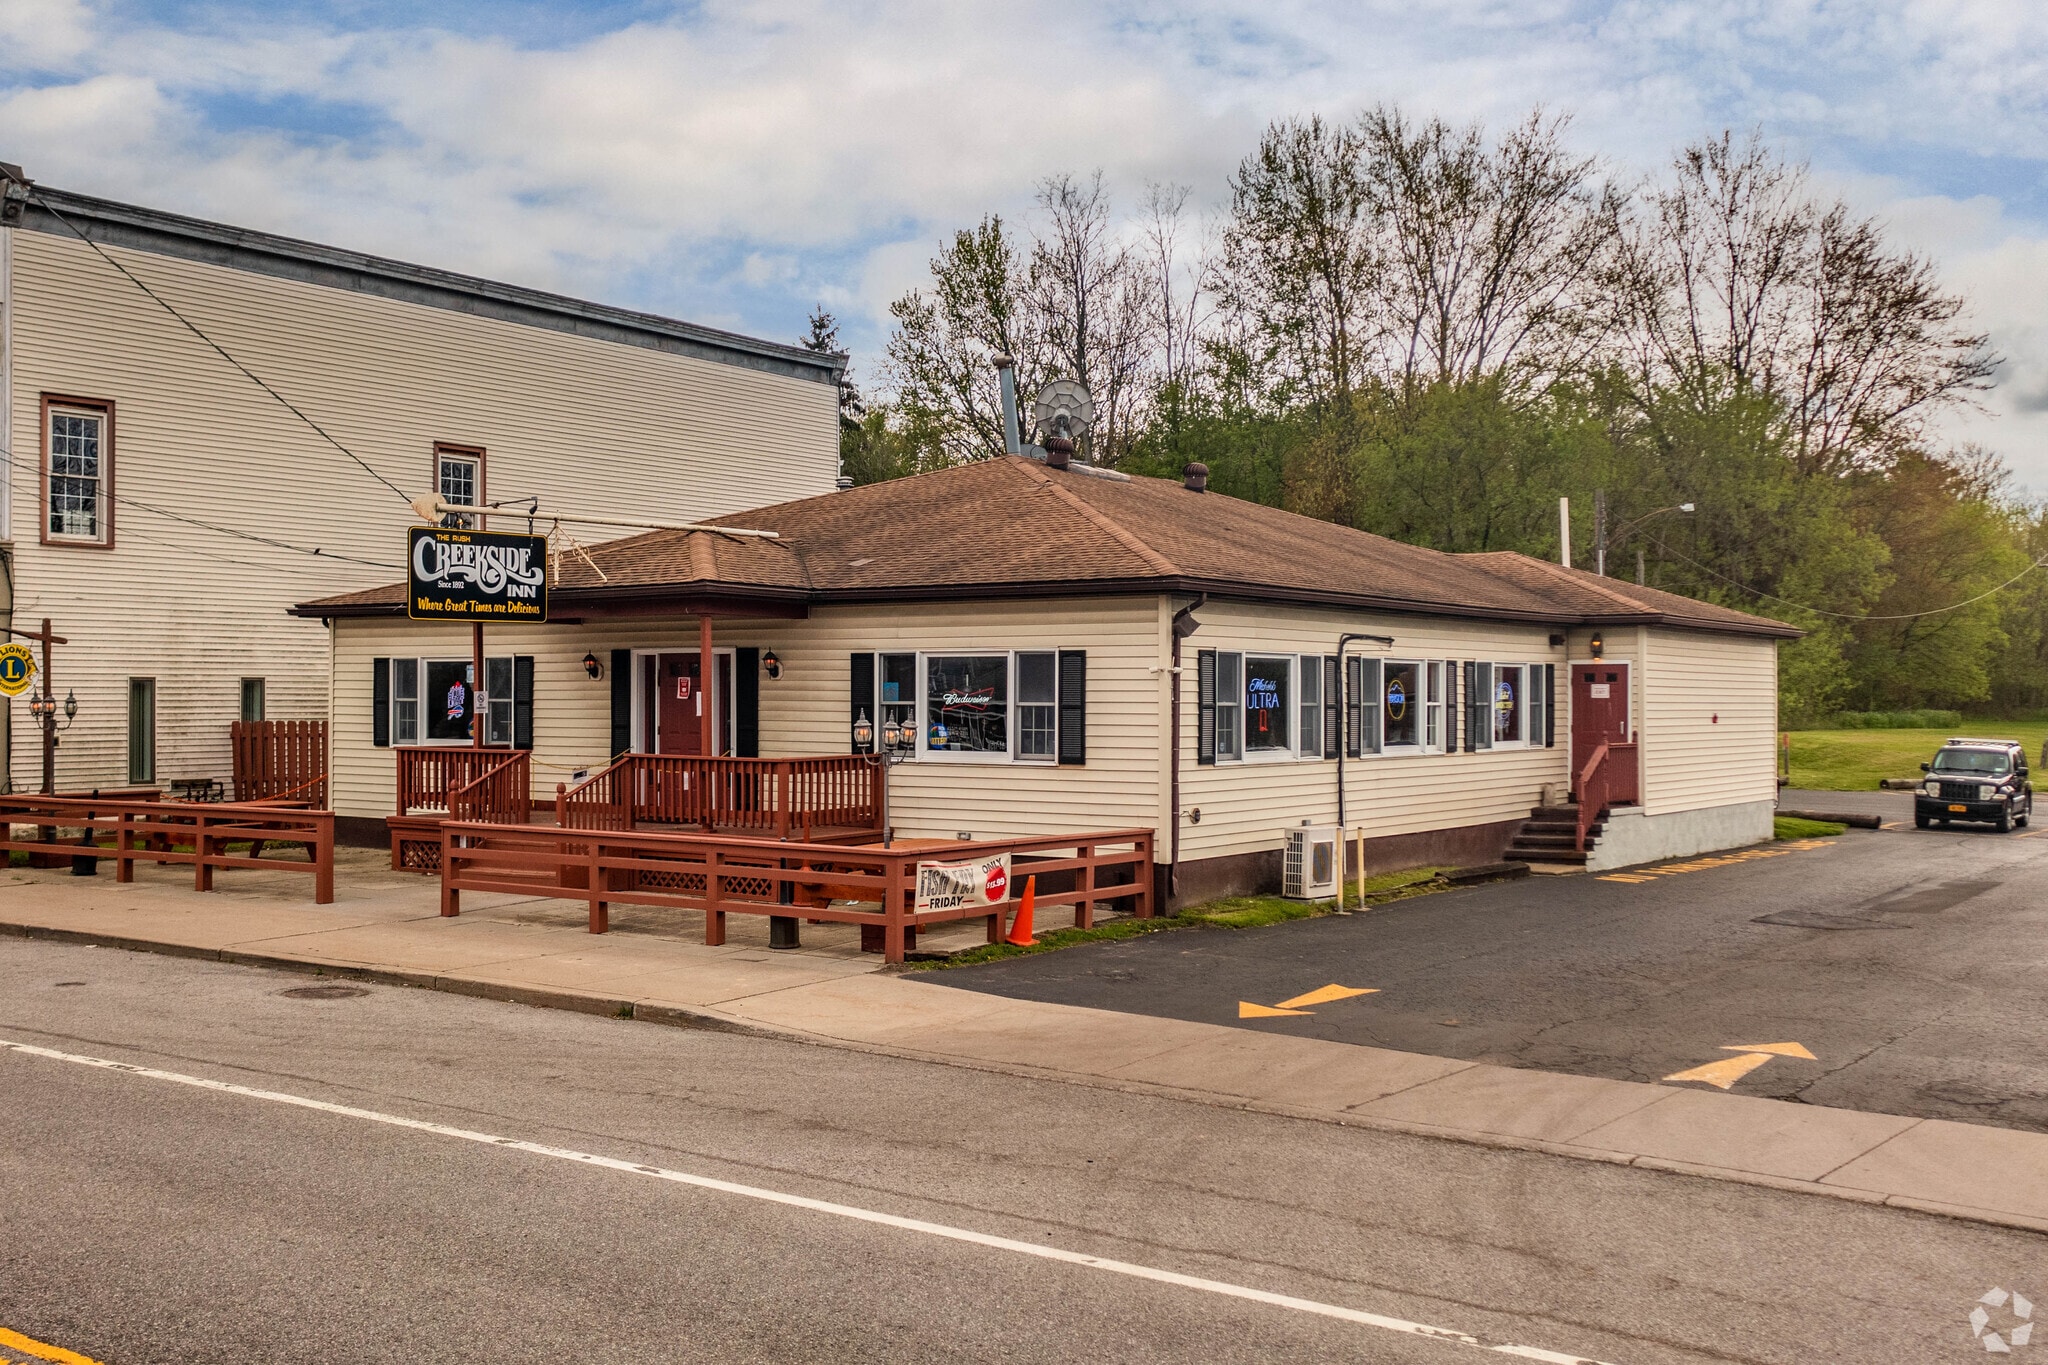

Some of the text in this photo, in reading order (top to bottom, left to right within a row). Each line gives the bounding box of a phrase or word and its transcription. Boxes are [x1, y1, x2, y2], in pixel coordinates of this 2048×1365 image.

[413, 536, 544, 594] CREEKSIDE
[438, 580, 465, 589] Since 1892
[507, 584, 536, 598] INN
[445, 598, 468, 612] Great
[469, 600, 492, 613] Times
[493, 603, 506, 613] are
[508, 600, 540, 615] Delicious
[0, 646, 27, 657] LIONS
[5, 659, 20, 679] L
[943, 693, 991, 705] Budweiser
[1246, 692, 1280, 709] ULTRA
[981, 858, 1002, 874] ONLY
[919, 869, 950, 897] FISH
[929, 896, 964, 909] FRIDAY
